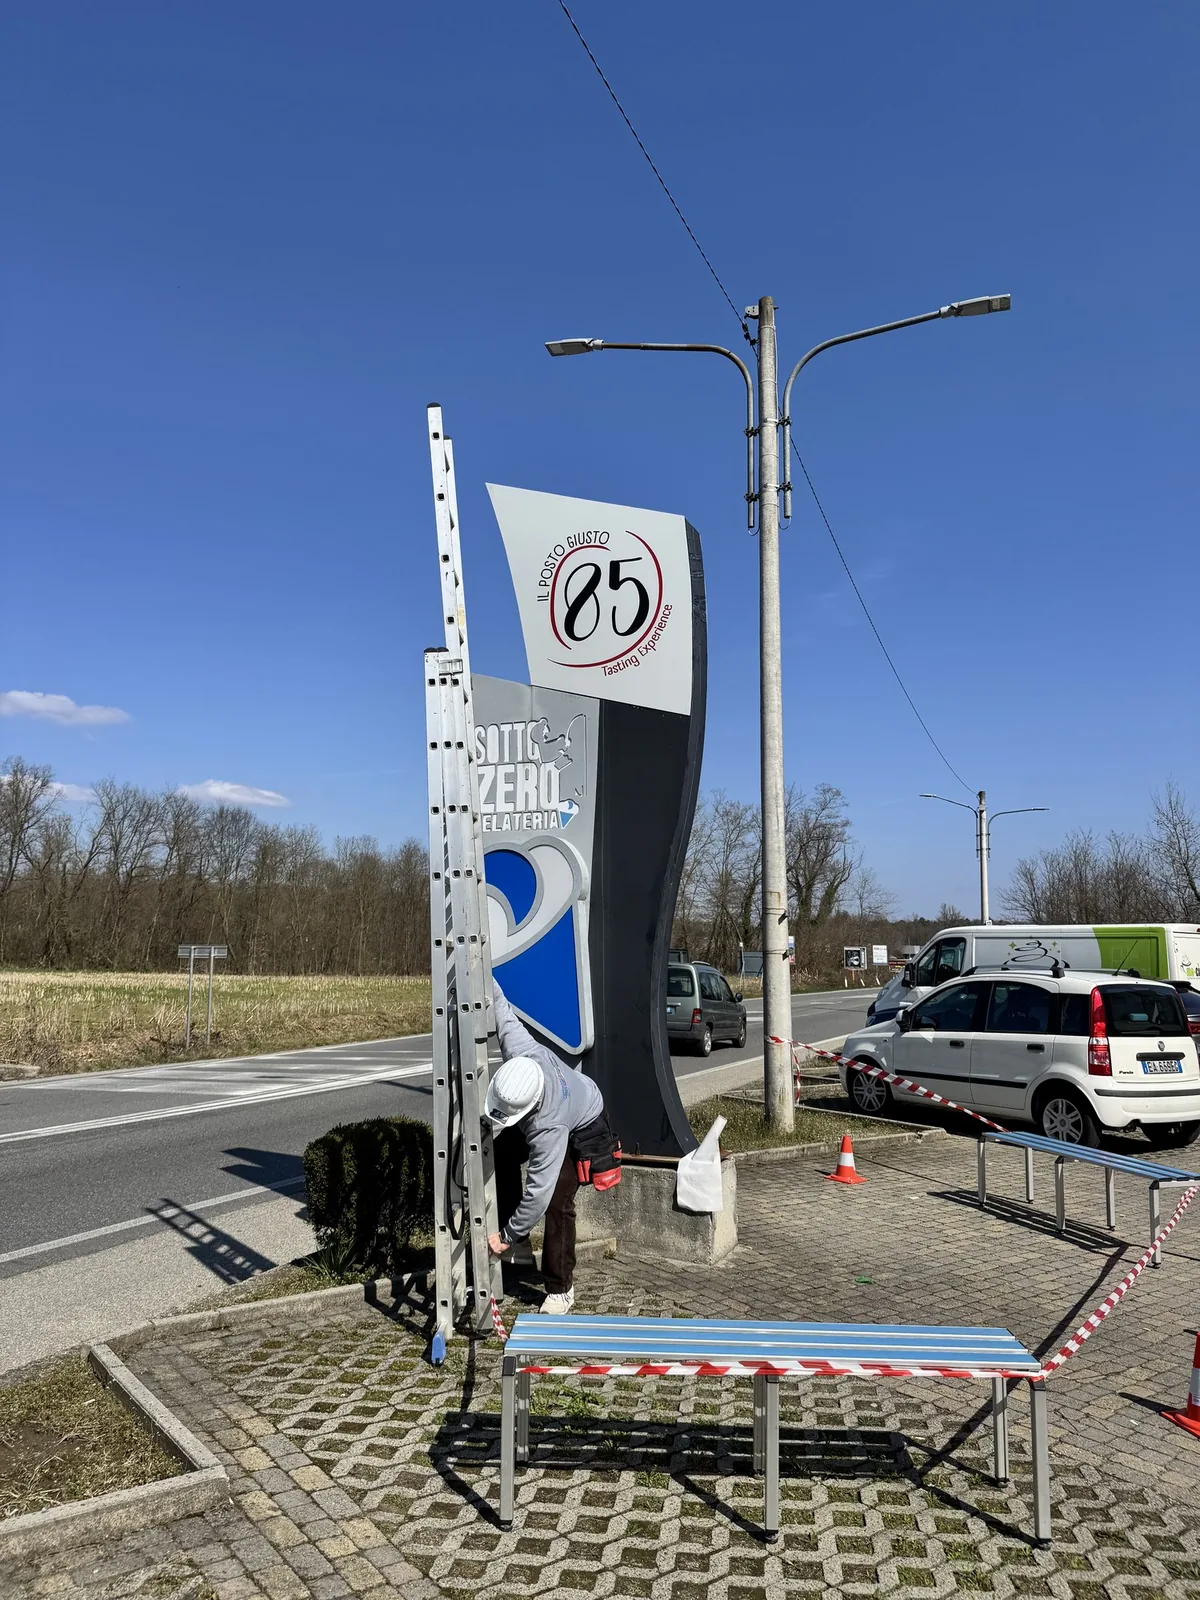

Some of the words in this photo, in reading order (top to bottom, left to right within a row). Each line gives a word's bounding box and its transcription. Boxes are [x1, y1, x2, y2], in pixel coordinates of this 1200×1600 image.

[566, 530, 610, 549] GIUSTO
[538, 544, 565, 587] POSTO
[537, 591, 550, 602] IL
[564, 556, 650, 642] 85
[601, 655, 641, 677] Tasting
[637, 603, 673, 657] Experience
[477, 761, 560, 813] ZERO
[481, 810, 560, 832] ELATERIA
